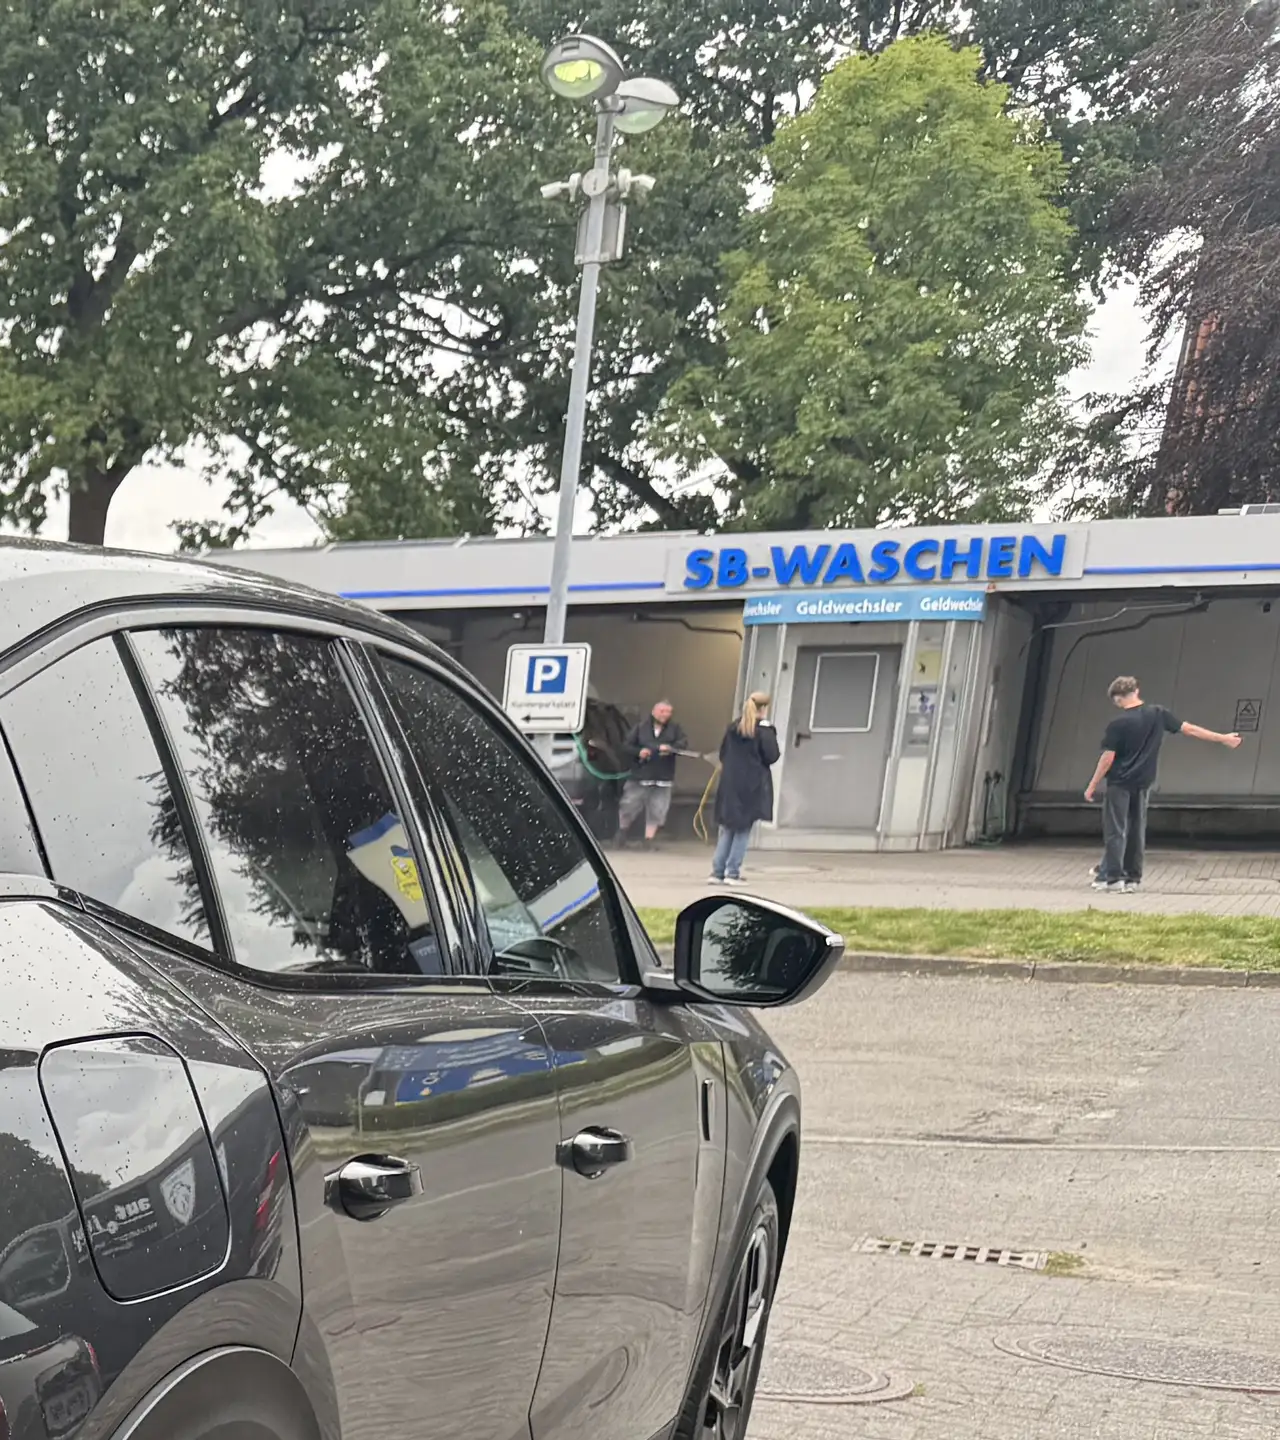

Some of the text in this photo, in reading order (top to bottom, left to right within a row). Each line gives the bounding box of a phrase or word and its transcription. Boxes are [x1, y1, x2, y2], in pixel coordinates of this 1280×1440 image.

[683, 534, 1067, 589] SB-WASCHEN
[796, 597, 903, 616] Geldwechsler
[533, 658, 561, 692] P
